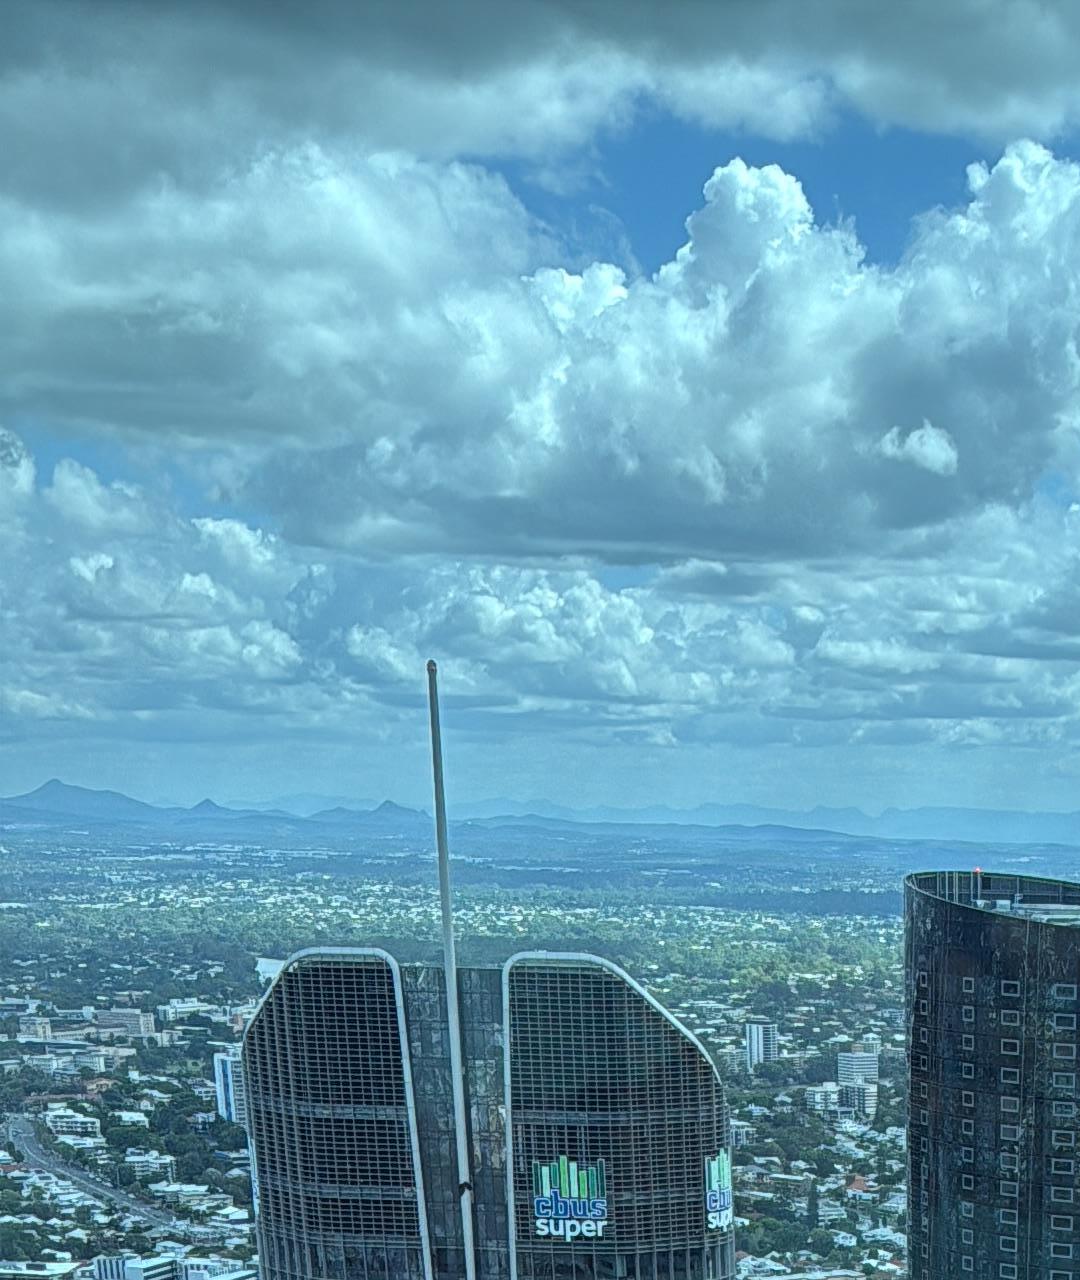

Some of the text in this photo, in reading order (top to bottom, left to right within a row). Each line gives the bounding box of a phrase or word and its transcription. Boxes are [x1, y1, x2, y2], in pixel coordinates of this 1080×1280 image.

[534, 1189, 608, 1219] cbus
[707, 1183, 732, 1211] cbu
[535, 1219, 608, 1242] super
[708, 1208, 733, 1232] sup
